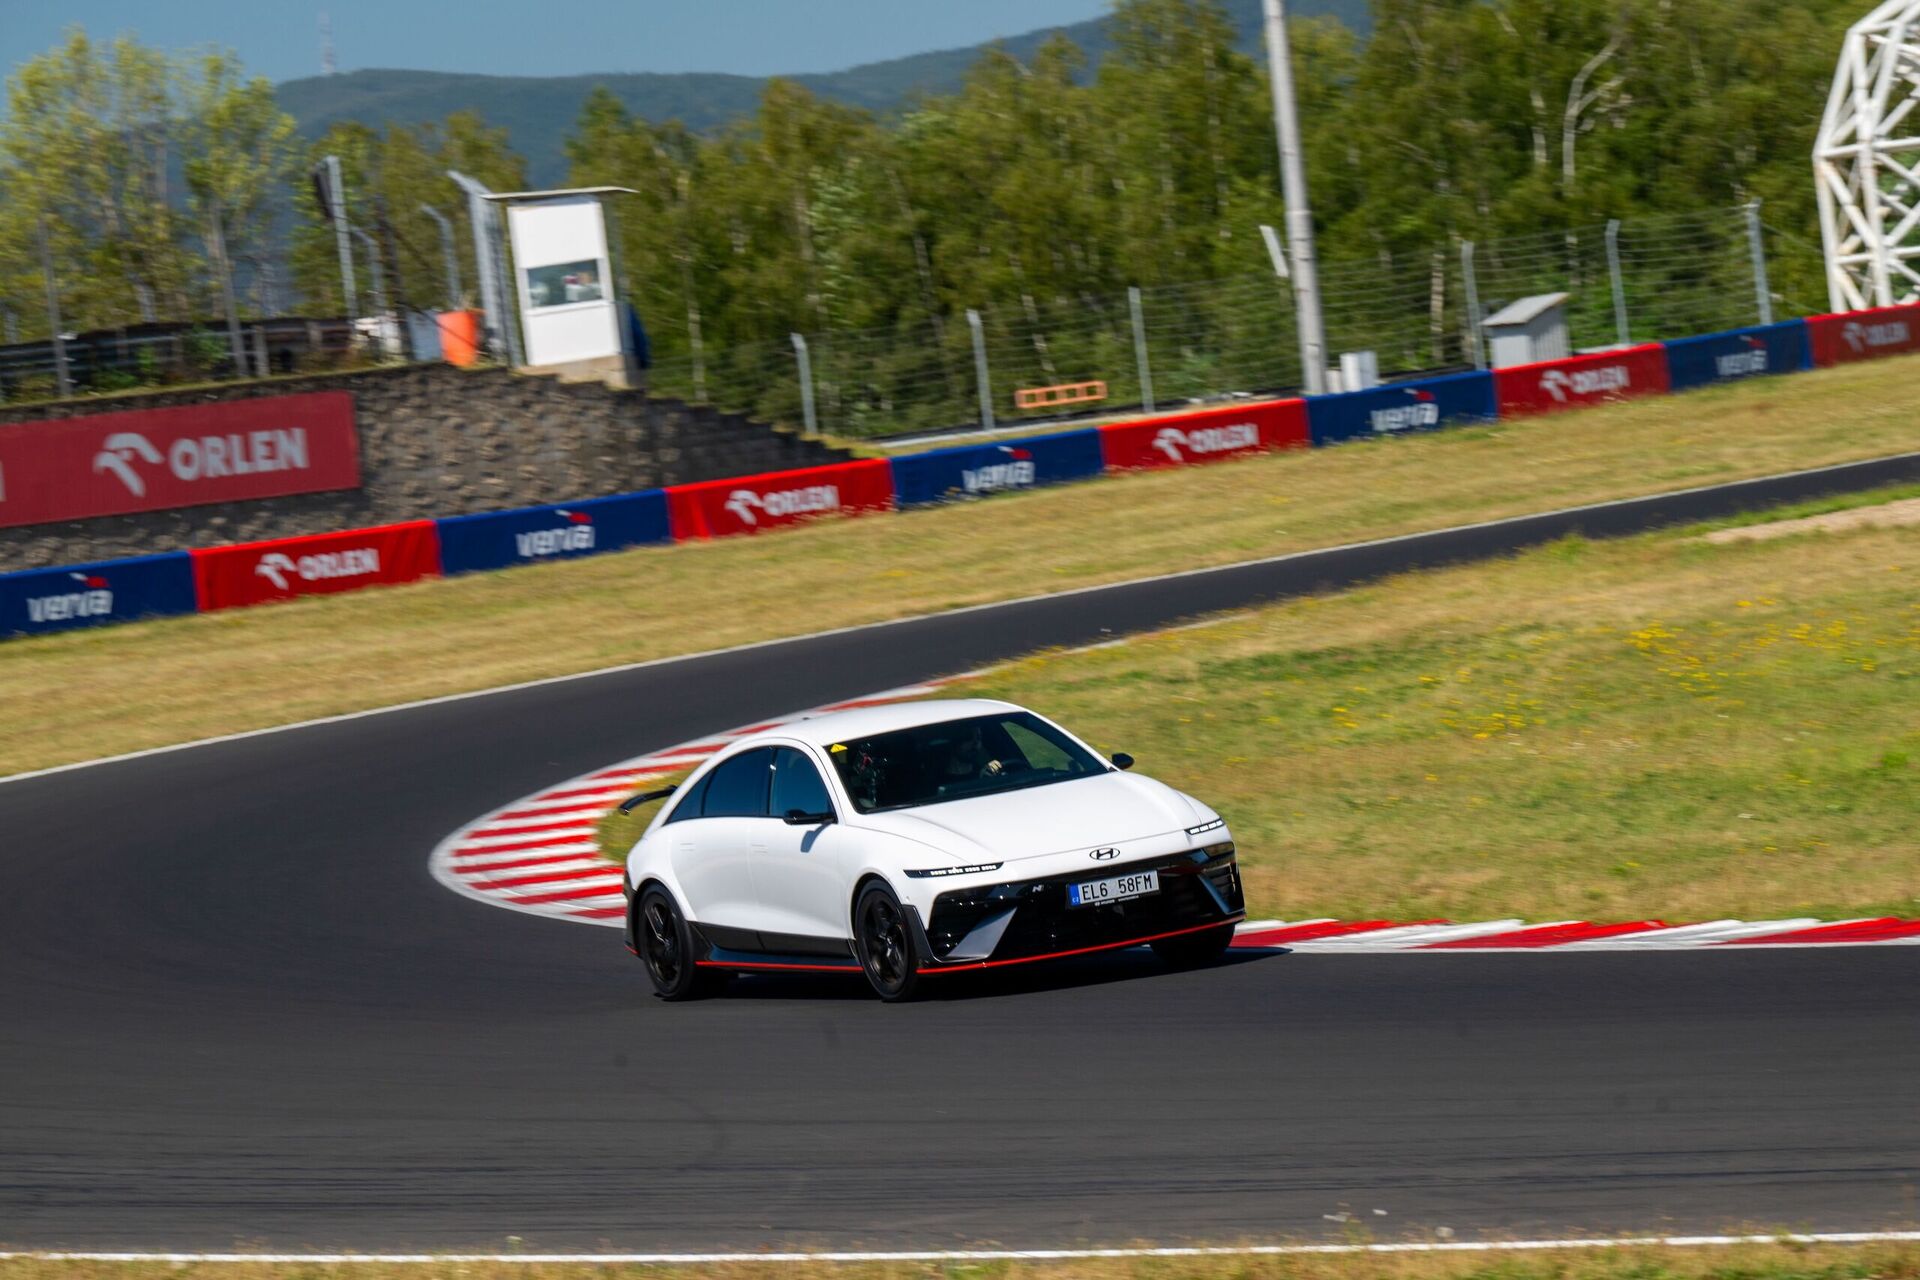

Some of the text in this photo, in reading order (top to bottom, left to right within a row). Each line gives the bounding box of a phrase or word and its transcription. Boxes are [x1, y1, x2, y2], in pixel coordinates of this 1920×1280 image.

[1568, 365, 1630, 394] ORLEN
[1188, 422, 1259, 453] ORLEN
[169, 428, 309, 481] ORLEN
[763, 484, 839, 517] ORLEN
[297, 547, 380, 580] ORLEN
[26, 589, 113, 622] verva
[1082, 874, 1153, 900] EL6 58FM
